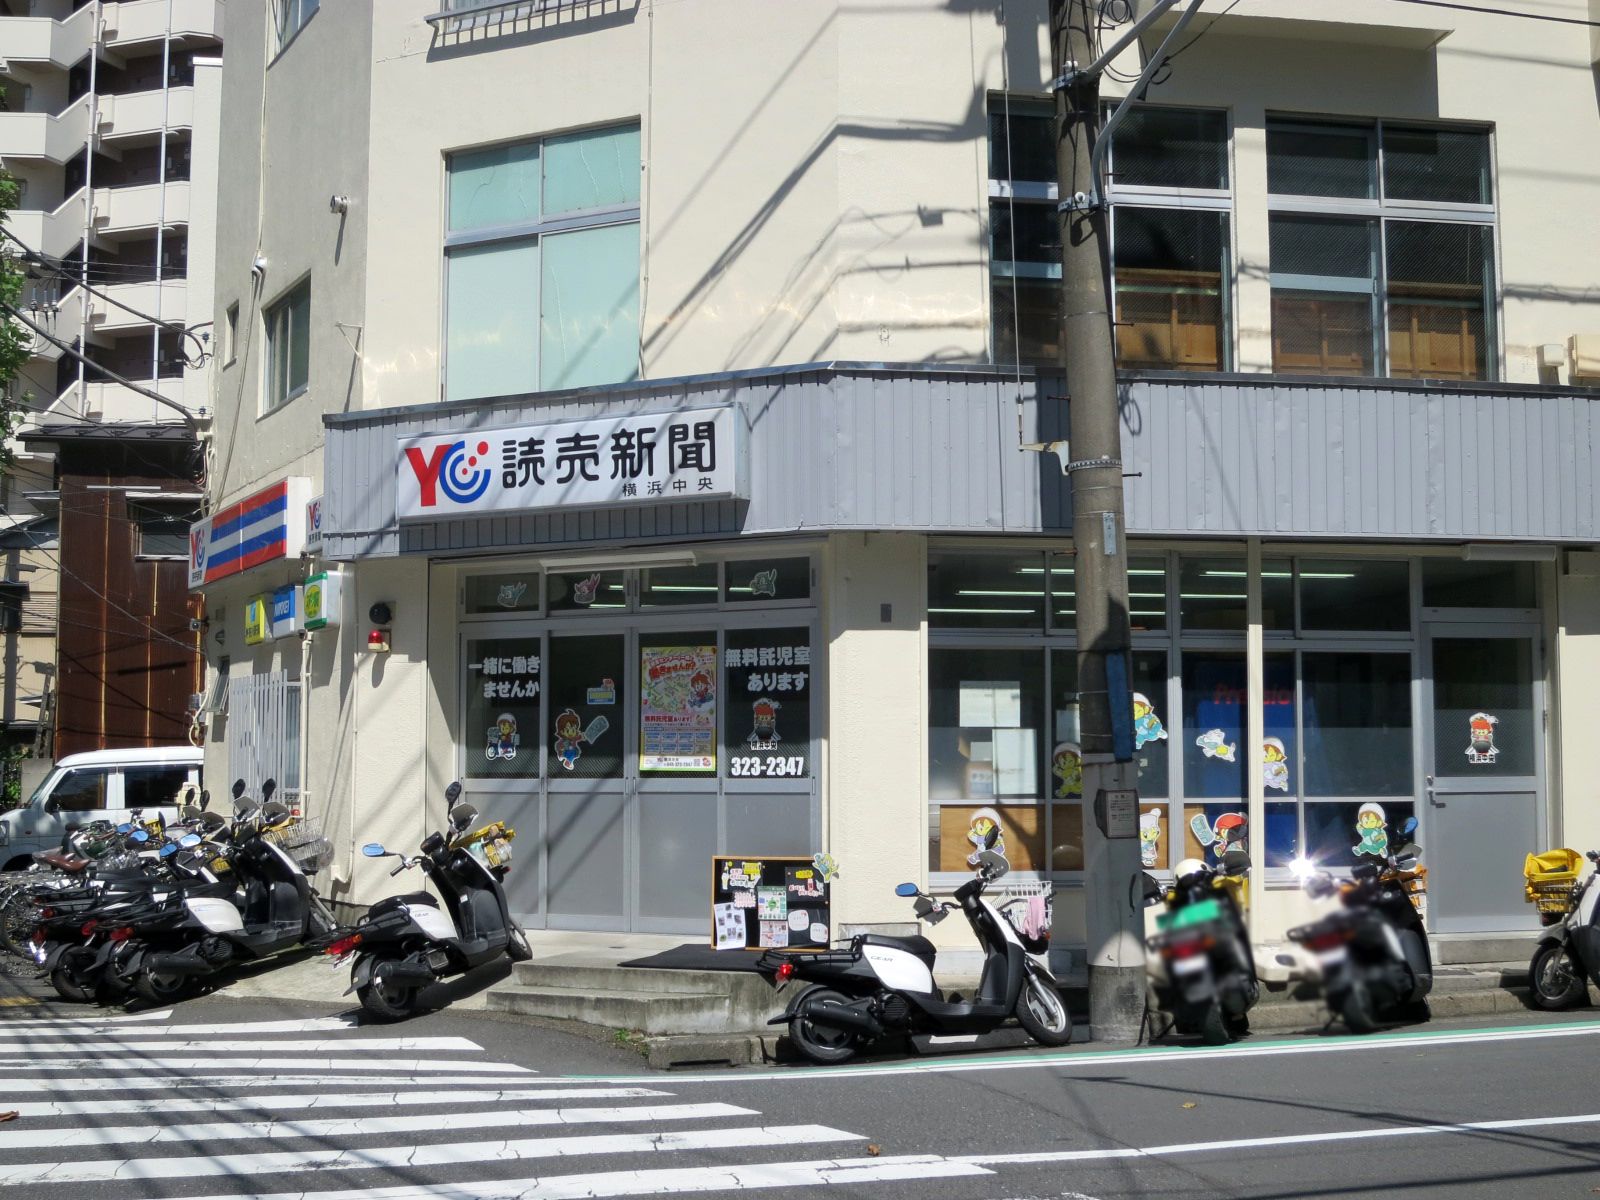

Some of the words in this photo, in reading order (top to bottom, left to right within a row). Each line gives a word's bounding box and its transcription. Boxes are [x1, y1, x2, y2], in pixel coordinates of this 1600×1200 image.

[502, 420, 716, 489] 読売新聞
[622, 477, 714, 497] 横浜中央
[468, 656, 540, 675] 一緒に働き
[725, 646, 811, 667] 無料託児室
[483, 680, 539, 698] ませんか
[747, 671, 808, 692] あります
[731, 756, 804, 776] 323-2347
